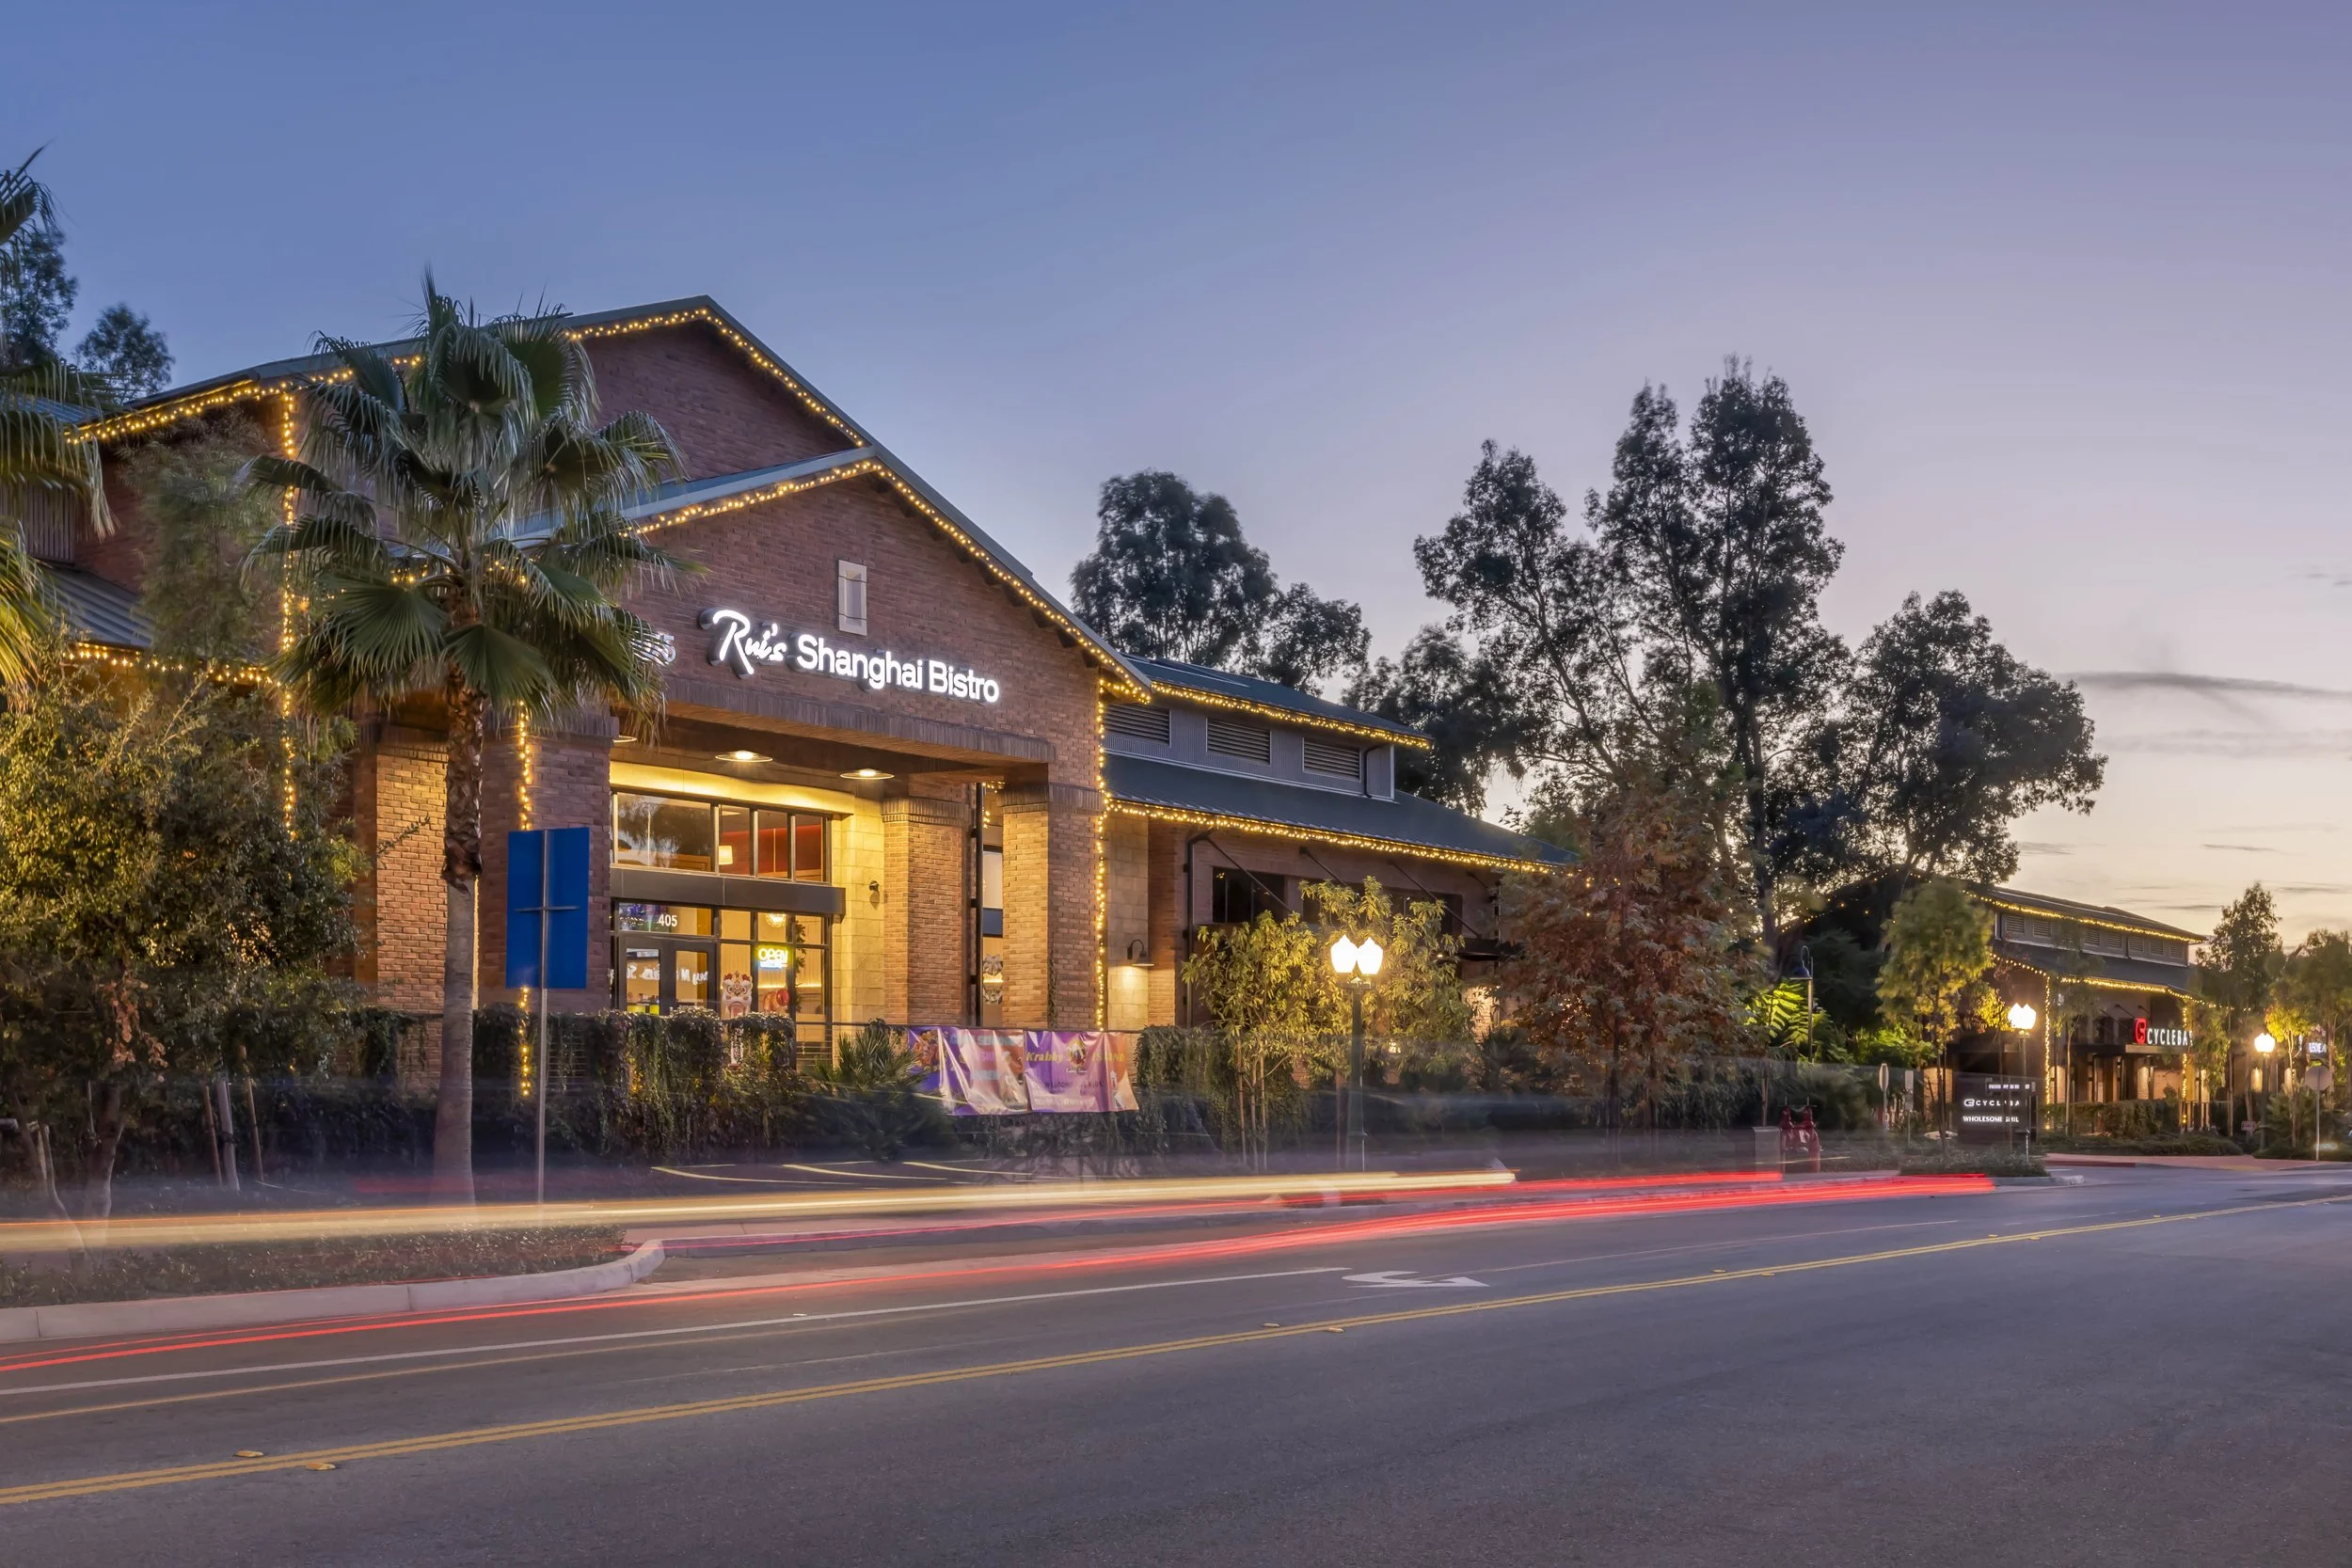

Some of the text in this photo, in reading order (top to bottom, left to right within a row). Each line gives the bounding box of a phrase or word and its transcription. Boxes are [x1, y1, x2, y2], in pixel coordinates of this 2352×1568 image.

[797, 634, 923, 689] Shanghai
[929, 659, 1000, 703] Bistro
[658, 913, 677, 927] 405
